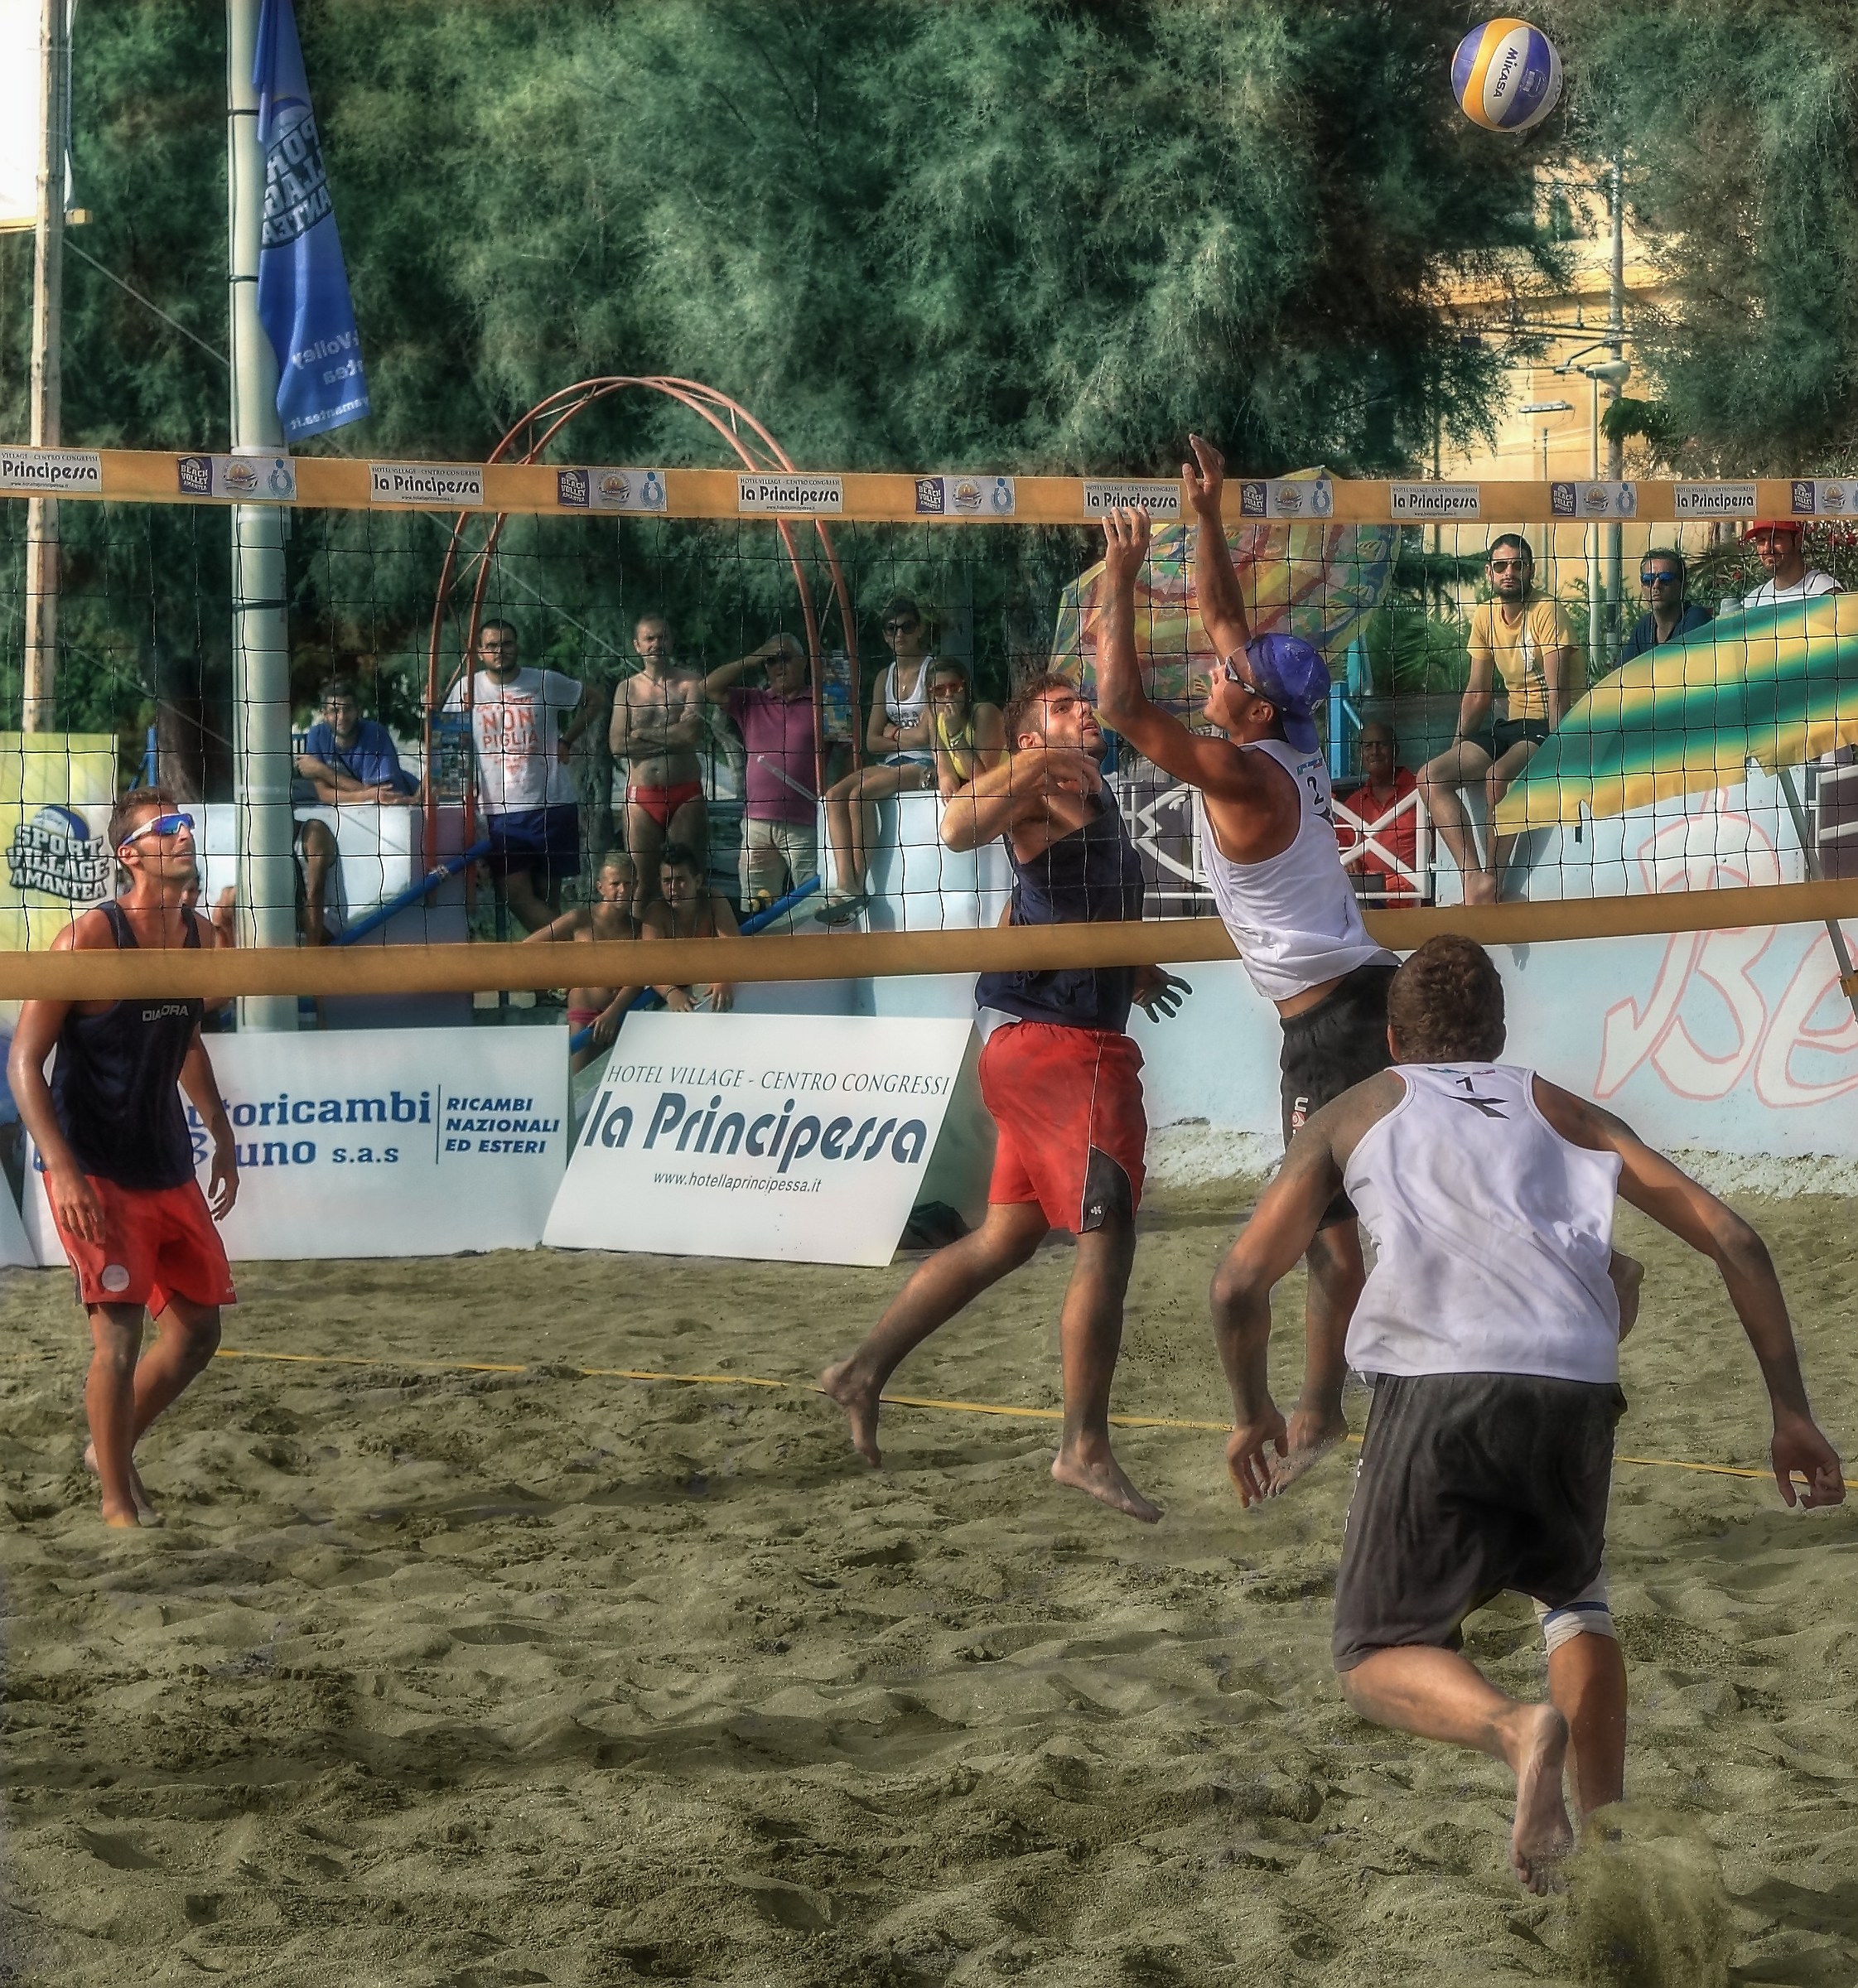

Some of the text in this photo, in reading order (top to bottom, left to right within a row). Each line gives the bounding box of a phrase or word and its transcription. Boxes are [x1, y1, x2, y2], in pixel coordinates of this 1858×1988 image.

[2, 460, 98, 482] Principessa
[181, 464, 209, 477] BEACH
[181, 472, 209, 485] VOLLEY
[374, 474, 480, 496] la Principessa
[741, 485, 839, 506] la Principessa
[1087, 491, 1100, 507] la
[1393, 494, 1477, 511] la Principessa
[1677, 493, 1754, 510] la Principessa
[482, 707, 535, 734] NON
[483, 730, 538, 749] PIGLIA
[1306, 776, 1325, 806] 2
[15, 825, 104, 856] SPORT
[7, 847, 110, 881] VILLAGE
[10, 868, 108, 901] AMANTEA
[142, 1004, 189, 1021] DIADORA
[607, 1065, 664, 1083] HOTEL
[671, 1067, 745, 1087] VILLAGE
[761, 1071, 837, 1091] CENTRO
[842, 1074, 950, 1095] CONGRESSI
[1455, 1076, 1474, 1093] 1
[446, 1097, 533, 1112] RICAMBI
[446, 1118, 560, 1132] NAZIONALI
[583, 1091, 928, 1174] la Principessa
[332, 1147, 399, 1163] s.a.s
[445, 1139, 547, 1153] ED ESTERI
[653, 1171, 822, 1194] www.hotellaprincipessa.it
